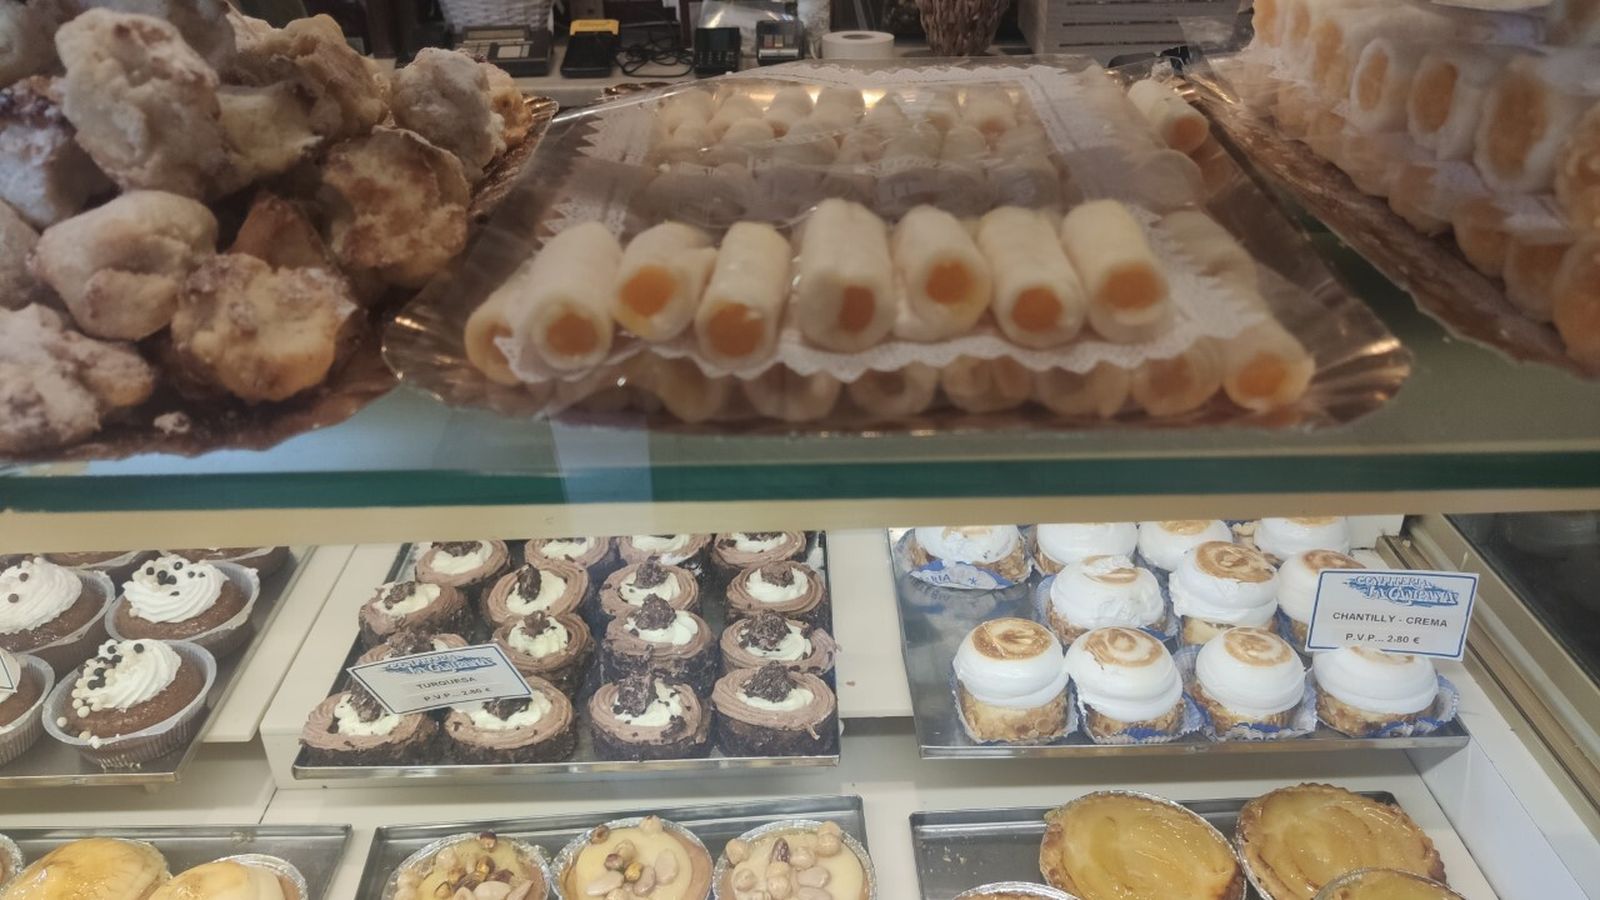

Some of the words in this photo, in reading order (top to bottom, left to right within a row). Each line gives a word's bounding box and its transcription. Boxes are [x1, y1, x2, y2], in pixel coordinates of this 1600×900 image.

[1332, 612, 1396, 623] CHANTILLY
[1405, 616, 1448, 627] CREMA
[1413, 636, 1421, 645] €
[416, 677, 477, 690] TURQUESA
